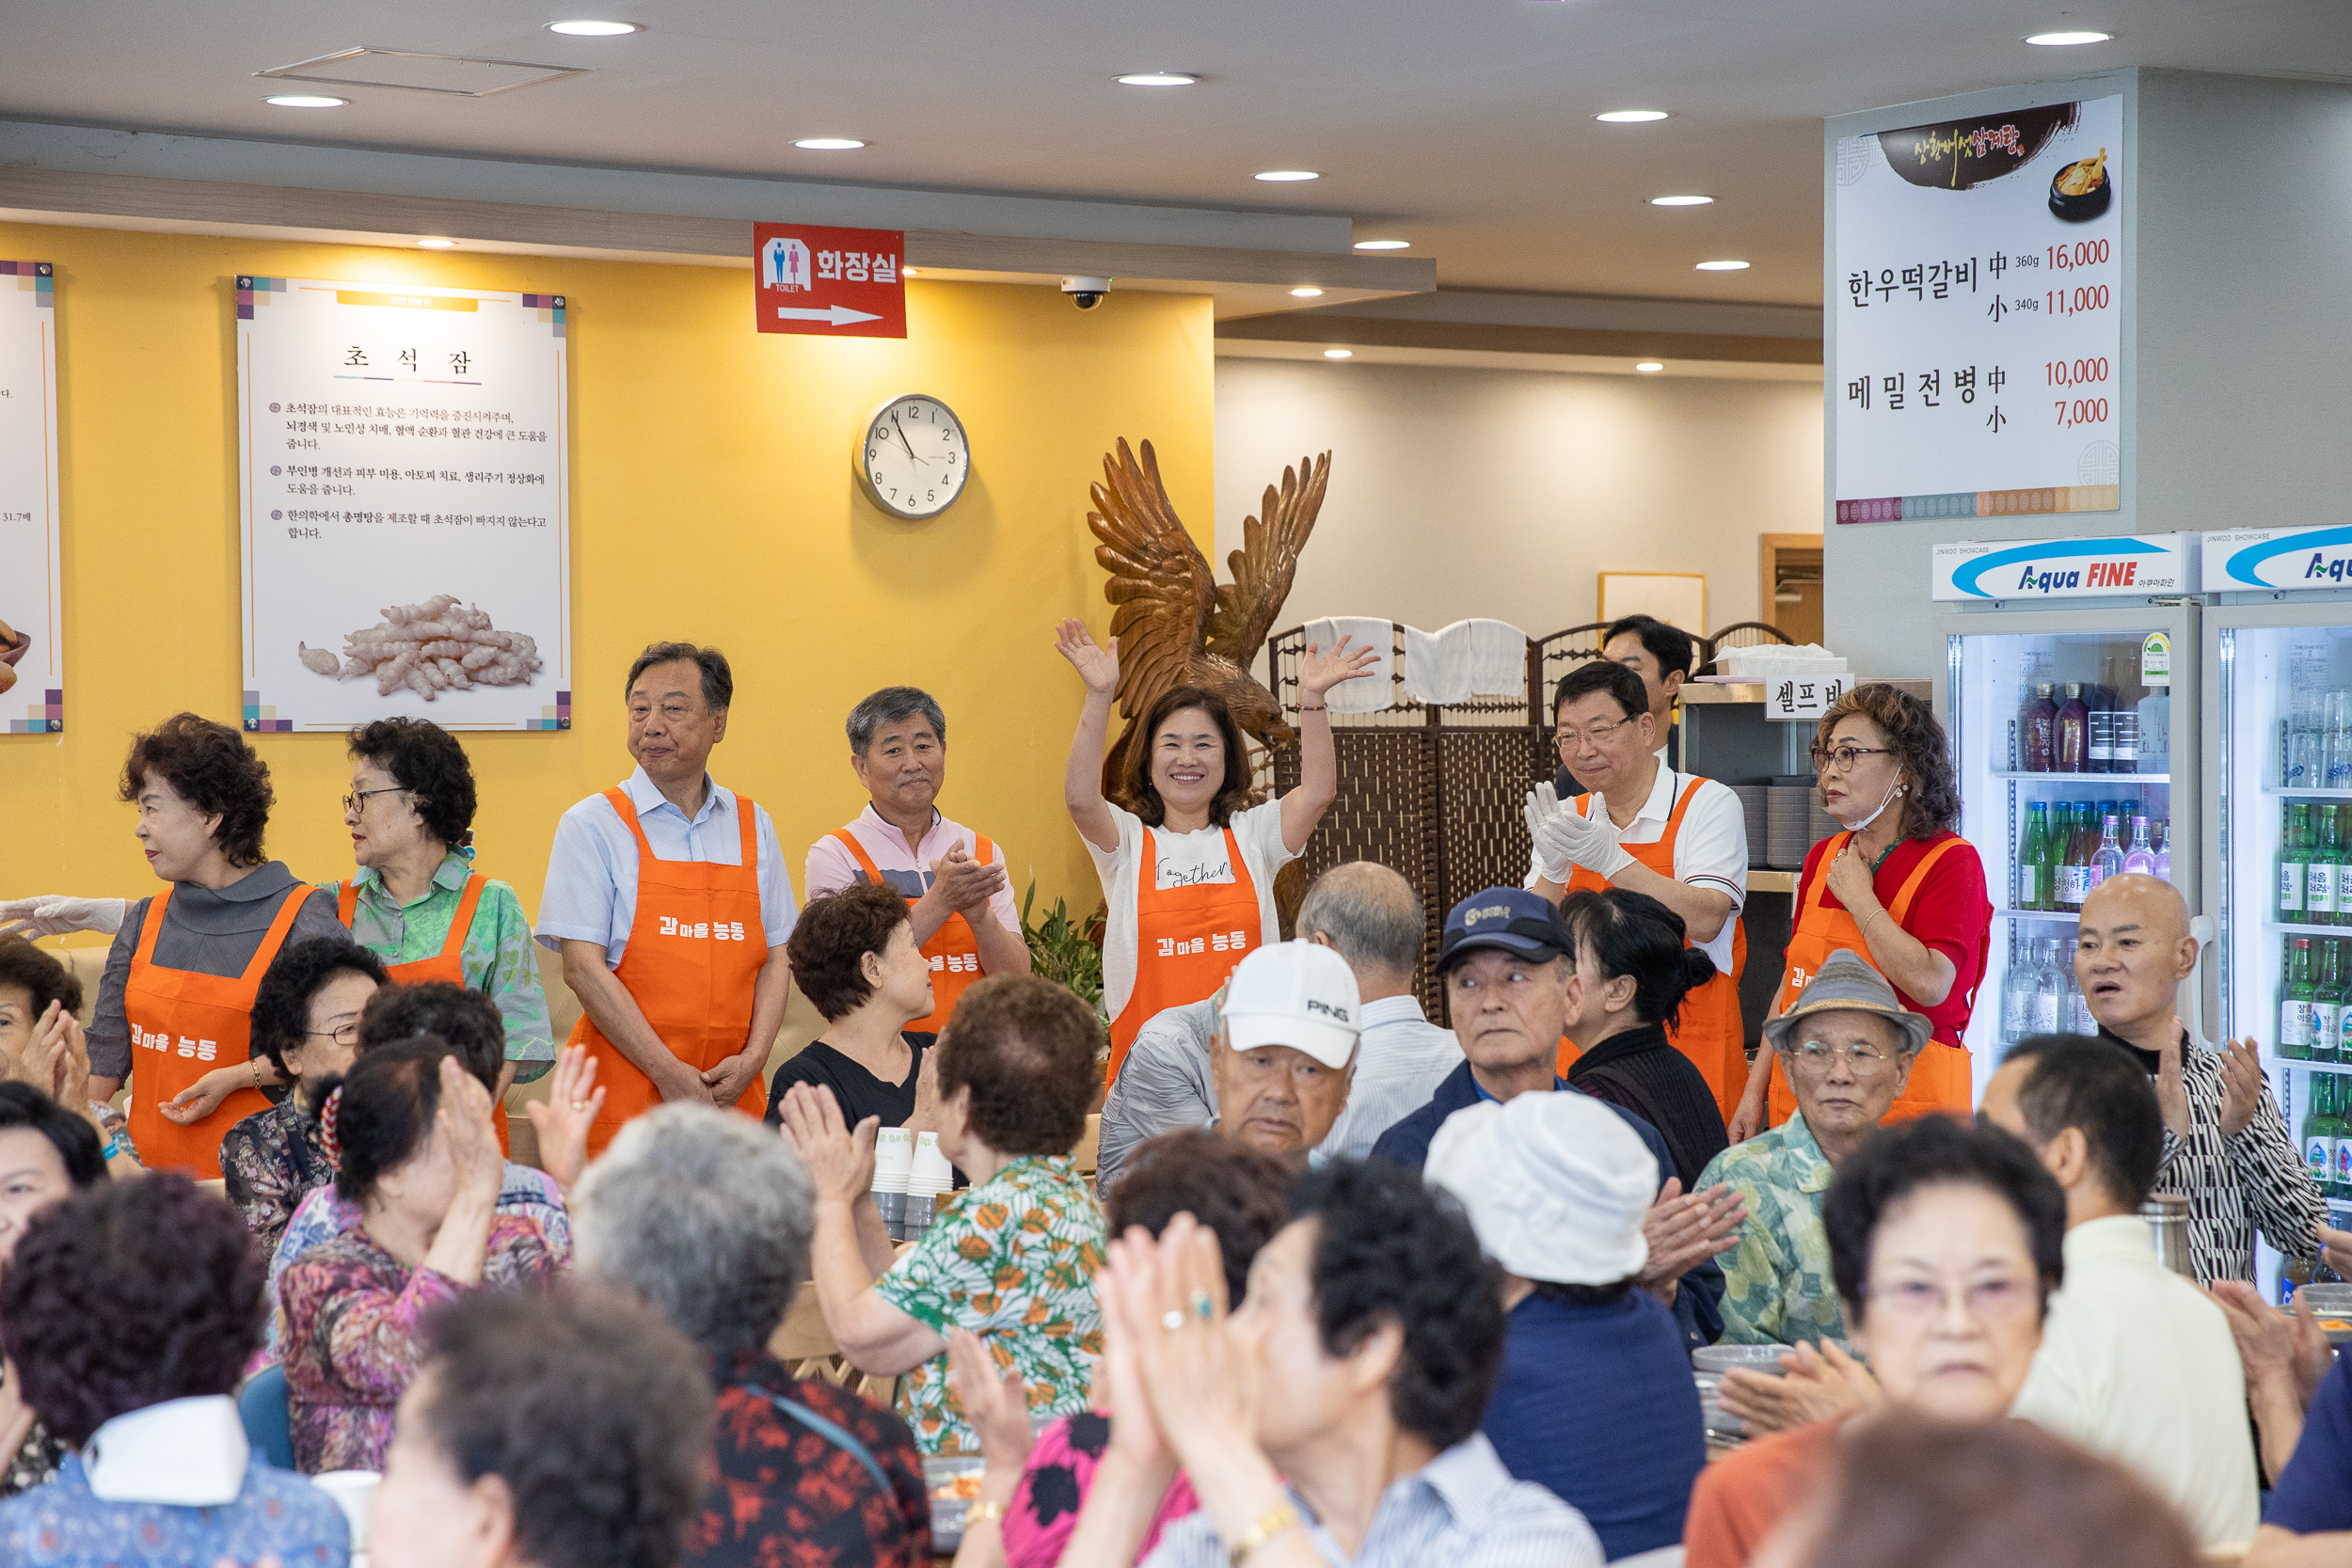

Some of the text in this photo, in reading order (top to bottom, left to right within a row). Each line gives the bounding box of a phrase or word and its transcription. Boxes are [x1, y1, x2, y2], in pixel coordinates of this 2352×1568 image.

[817, 249, 897, 283] 화장실
[1848, 239, 2109, 308] 한우떡갈비 中 360g 16,000
[775, 283, 799, 293] TOILET
[1987, 284, 2109, 323] 小 340g 11,000
[1988, 366, 2006, 394] 中
[2045, 357, 2108, 389] 10,000
[285, 403, 327, 415] 초석잠의
[331, 404, 373, 418] 대표적인
[375, 406, 406, 419] 효능은
[409, 408, 450, 420] 기억력을
[908, 406, 919, 419] 12
[1986, 398, 2108, 434] 小 7,000
[286, 420, 318, 433] 뇌경색
[335, 422, 365, 435] 노인성
[395, 424, 415, 436] 혈액
[418, 426, 448, 438] 순환과
[452, 427, 471, 439] 혈관
[474, 429, 503, 441] 건강에
[506, 430, 516, 441] 큰
[517, 431, 548, 442] 도움을
[875, 427, 889, 440] 10
[943, 428, 950, 441] 2
[286, 438, 321, 451] 줍니다.
[869, 449, 877, 462] 9
[947, 451, 956, 465] 3
[287, 466, 318, 478] 부인병
[321, 467, 353, 479] 개선과
[356, 467, 376, 479] 피부
[405, 469, 436, 482] 아토피
[465, 471, 503, 483] 생리주기
[506, 473, 545, 485] 정상화에
[875, 472, 882, 484] 8
[942, 474, 949, 485] 4
[287, 483, 356, 497] 도움을 줍니다.
[890, 488, 898, 500] 7
[927, 490, 935, 502] 5
[908, 495, 916, 507] 6
[3, 512, 31, 522] 31.7배
[288, 510, 547, 528] 한의학에서 총명탕을 제조할 때 초석잠이 빠지지 않는다고
[288, 527, 322, 540] 합니다.
[2207, 532, 2270, 543] JINWOO SHOWCASE
[1959, 546, 1990, 555] SHOWCASE
[2018, 562, 2175, 594] Aqua FINE 아쿠아파인
[1155, 857, 1228, 888] Together
[2310, 871, 2328, 882] 처음
[660, 916, 745, 941] 감마을 능동
[1156, 930, 1247, 957] 감마을 능동
[946, 953, 977, 973] 능동
[1308, 1000, 1348, 1022] PING
[131, 1022, 217, 1061] 감마을 능동
